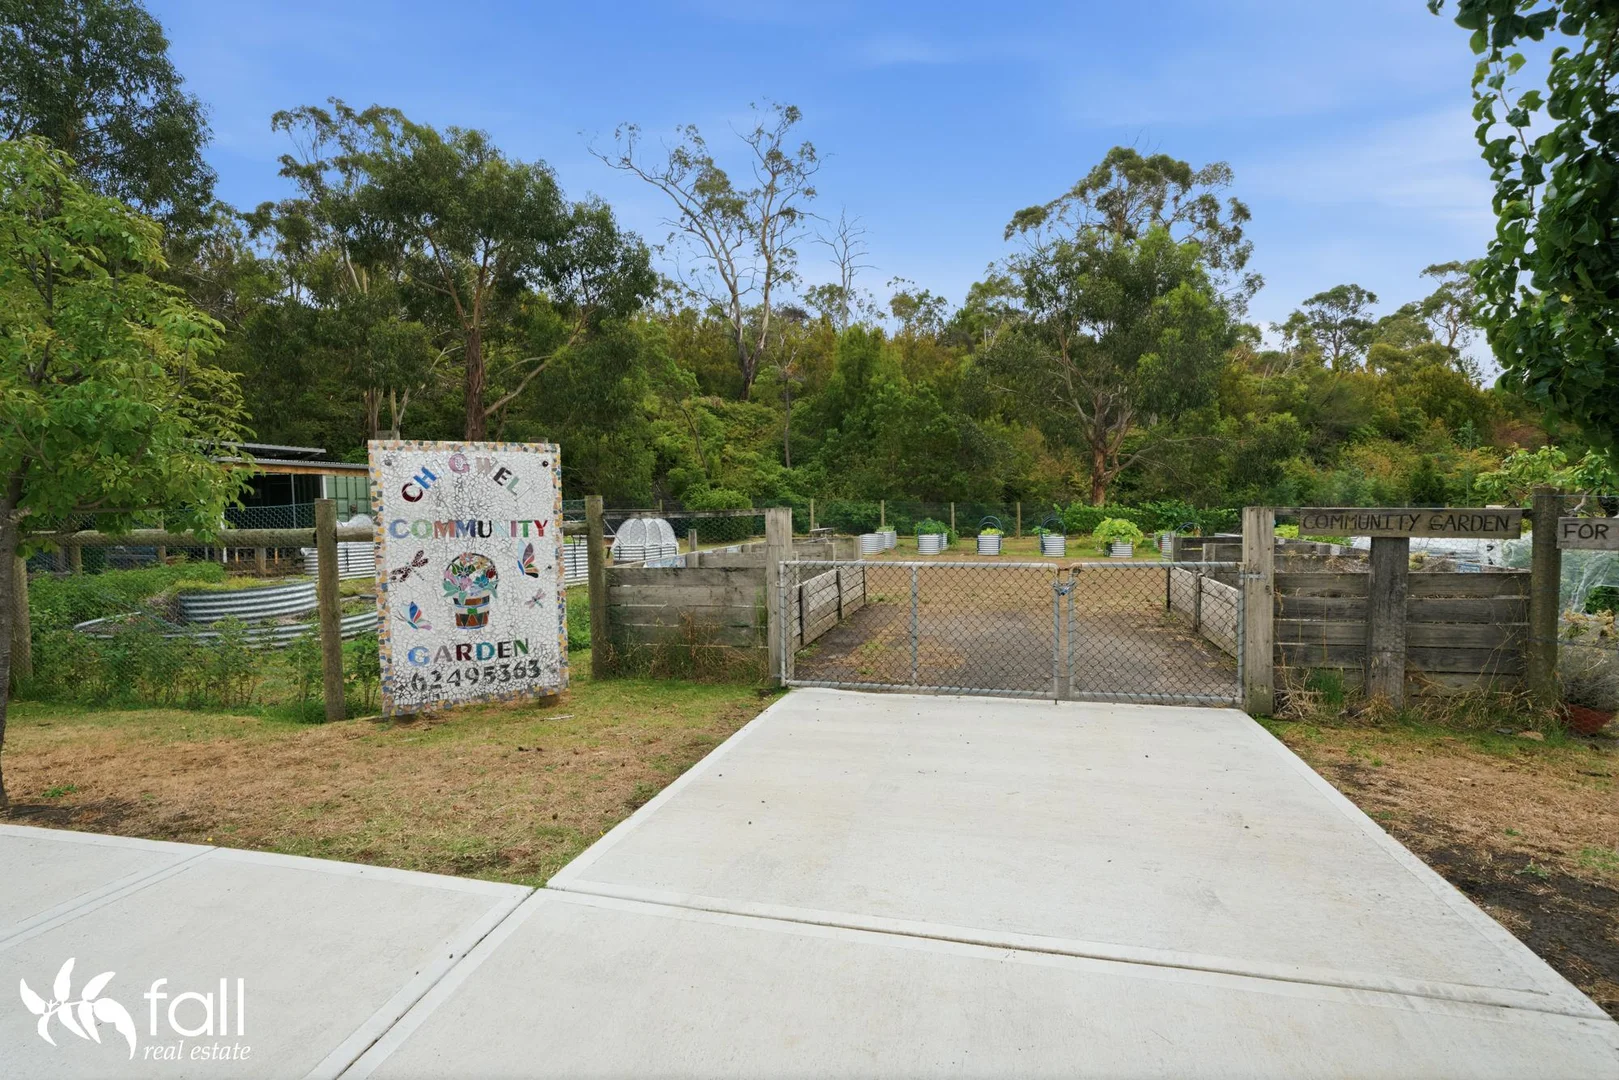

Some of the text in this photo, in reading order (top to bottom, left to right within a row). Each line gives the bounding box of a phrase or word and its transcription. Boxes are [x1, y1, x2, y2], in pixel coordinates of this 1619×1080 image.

[388, 518, 548, 539] COMMUNITY
[1302, 513, 1511, 532] COMMUNITY GARDEN
[1563, 523, 1610, 540] FOR
[407, 638, 529, 667] GARDEN
[410, 659, 542, 692] 62495363
